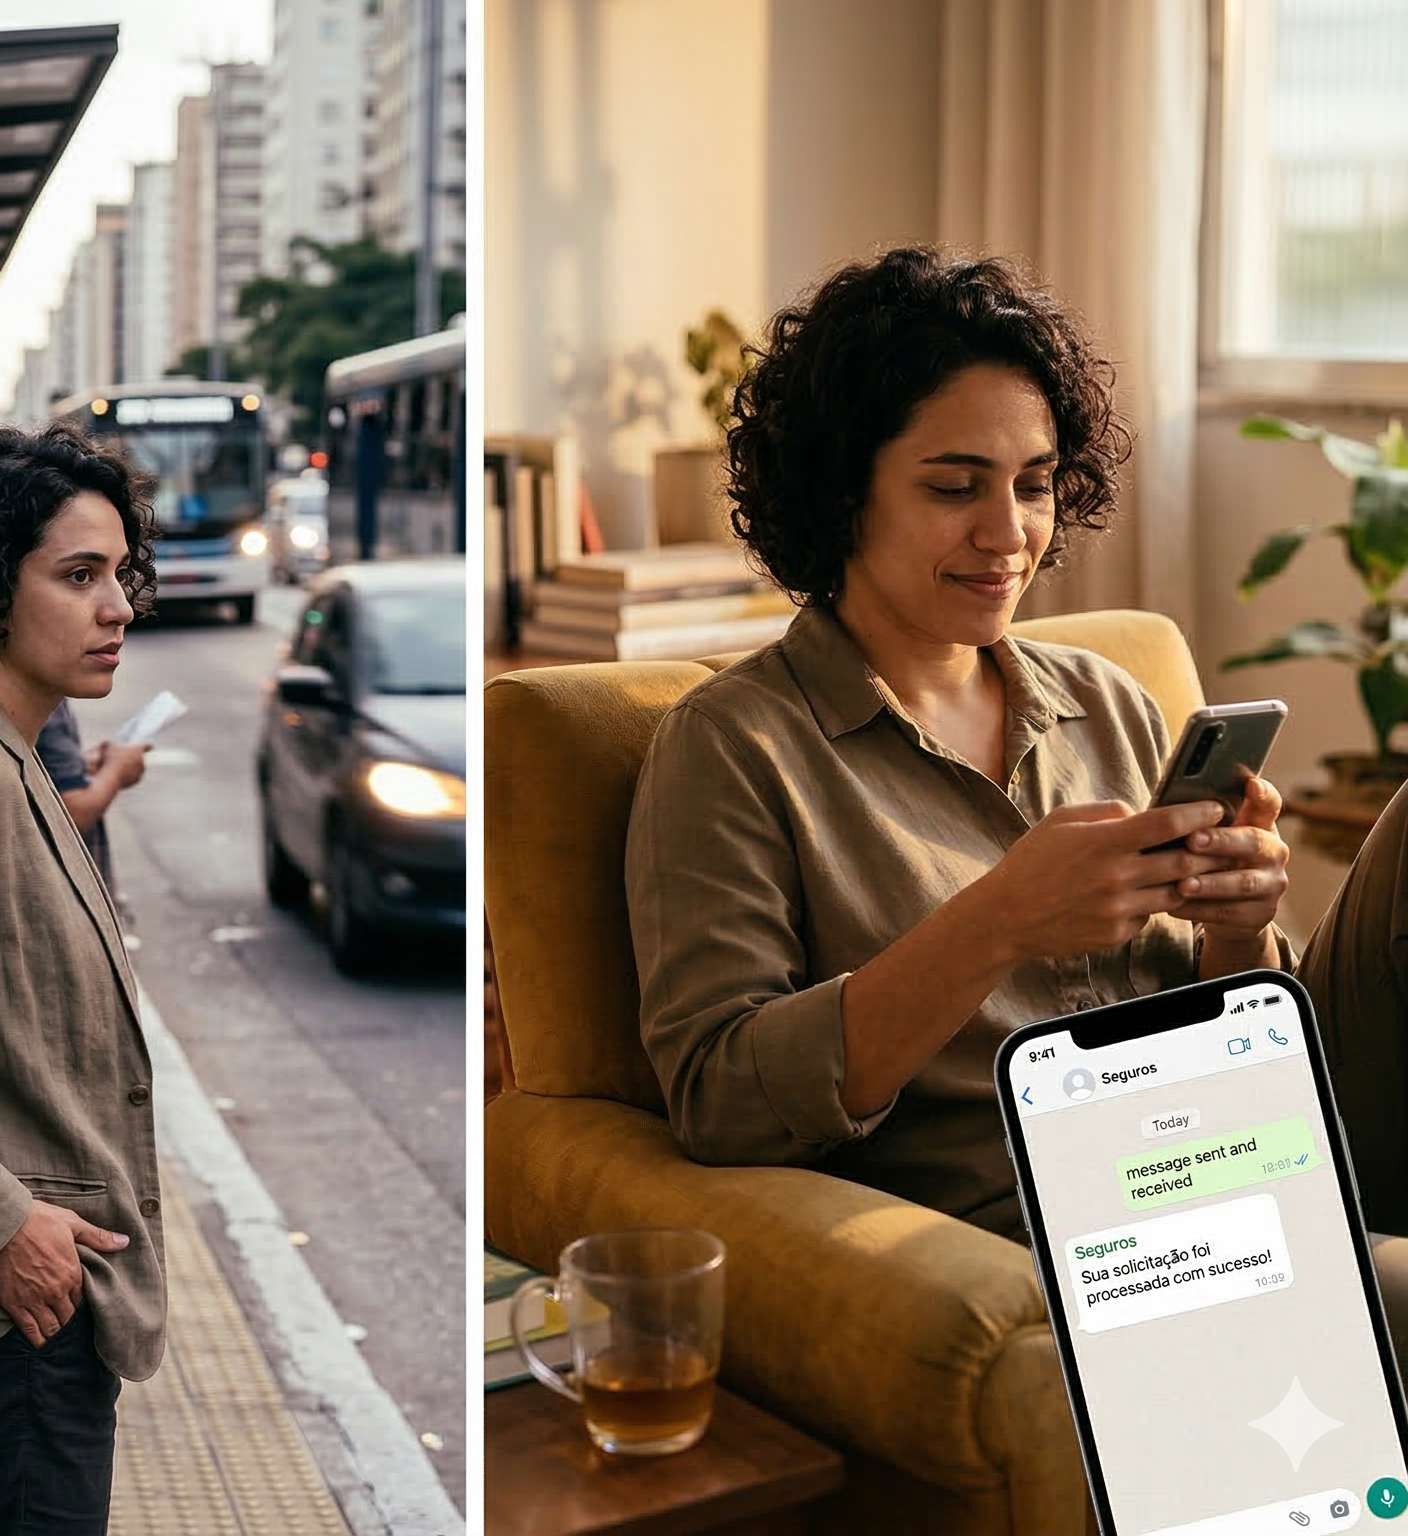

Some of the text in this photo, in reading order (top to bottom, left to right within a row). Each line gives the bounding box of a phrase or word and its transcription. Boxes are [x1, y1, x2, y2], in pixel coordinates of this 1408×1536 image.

[1100, 1062, 1158, 1086] Seguros
[1152, 1113, 1190, 1133] Today
[1126, 1138, 1258, 1182] message sent and
[1130, 1173, 1194, 1201] received
[1074, 1235, 1138, 1261] Seguros
[1081, 1242, 1212, 1285] Sua solicitação foi
[1086, 1249, 1273, 1308] processada com sucesso!
